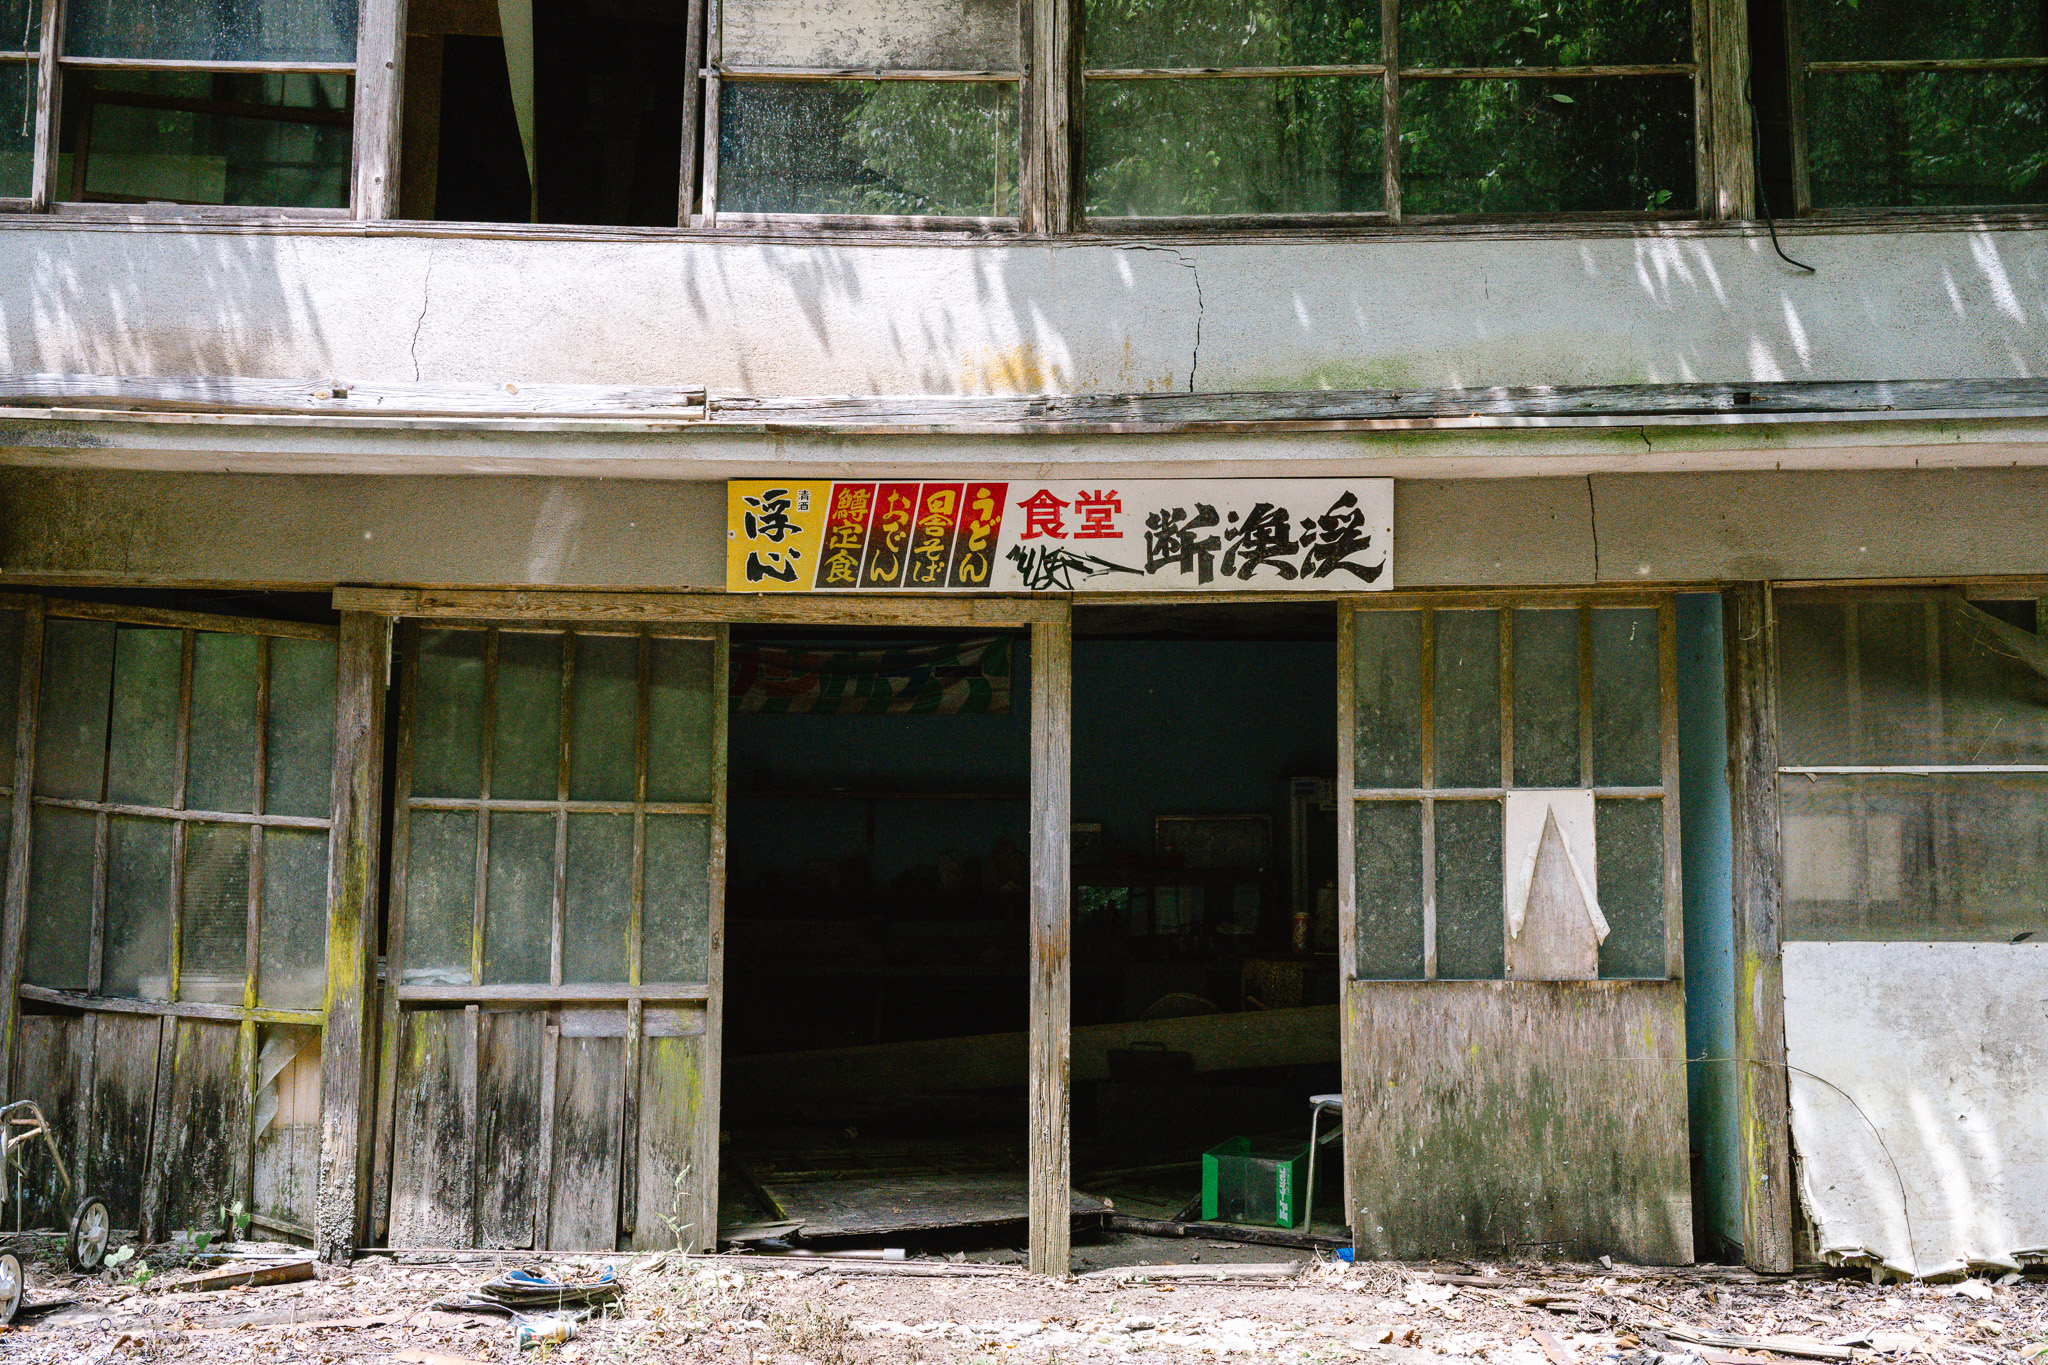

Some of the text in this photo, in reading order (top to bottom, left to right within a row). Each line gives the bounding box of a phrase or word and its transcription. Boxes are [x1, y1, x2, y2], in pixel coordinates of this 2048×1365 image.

[798, 489, 811, 511] 清酒
[824, 487, 871, 583] 鱒定食
[870, 489, 911, 582] おでん
[913, 489, 956, 583] 田舎そば
[959, 487, 1001, 583] うどん
[1016, 489, 1124, 541] 食堂
